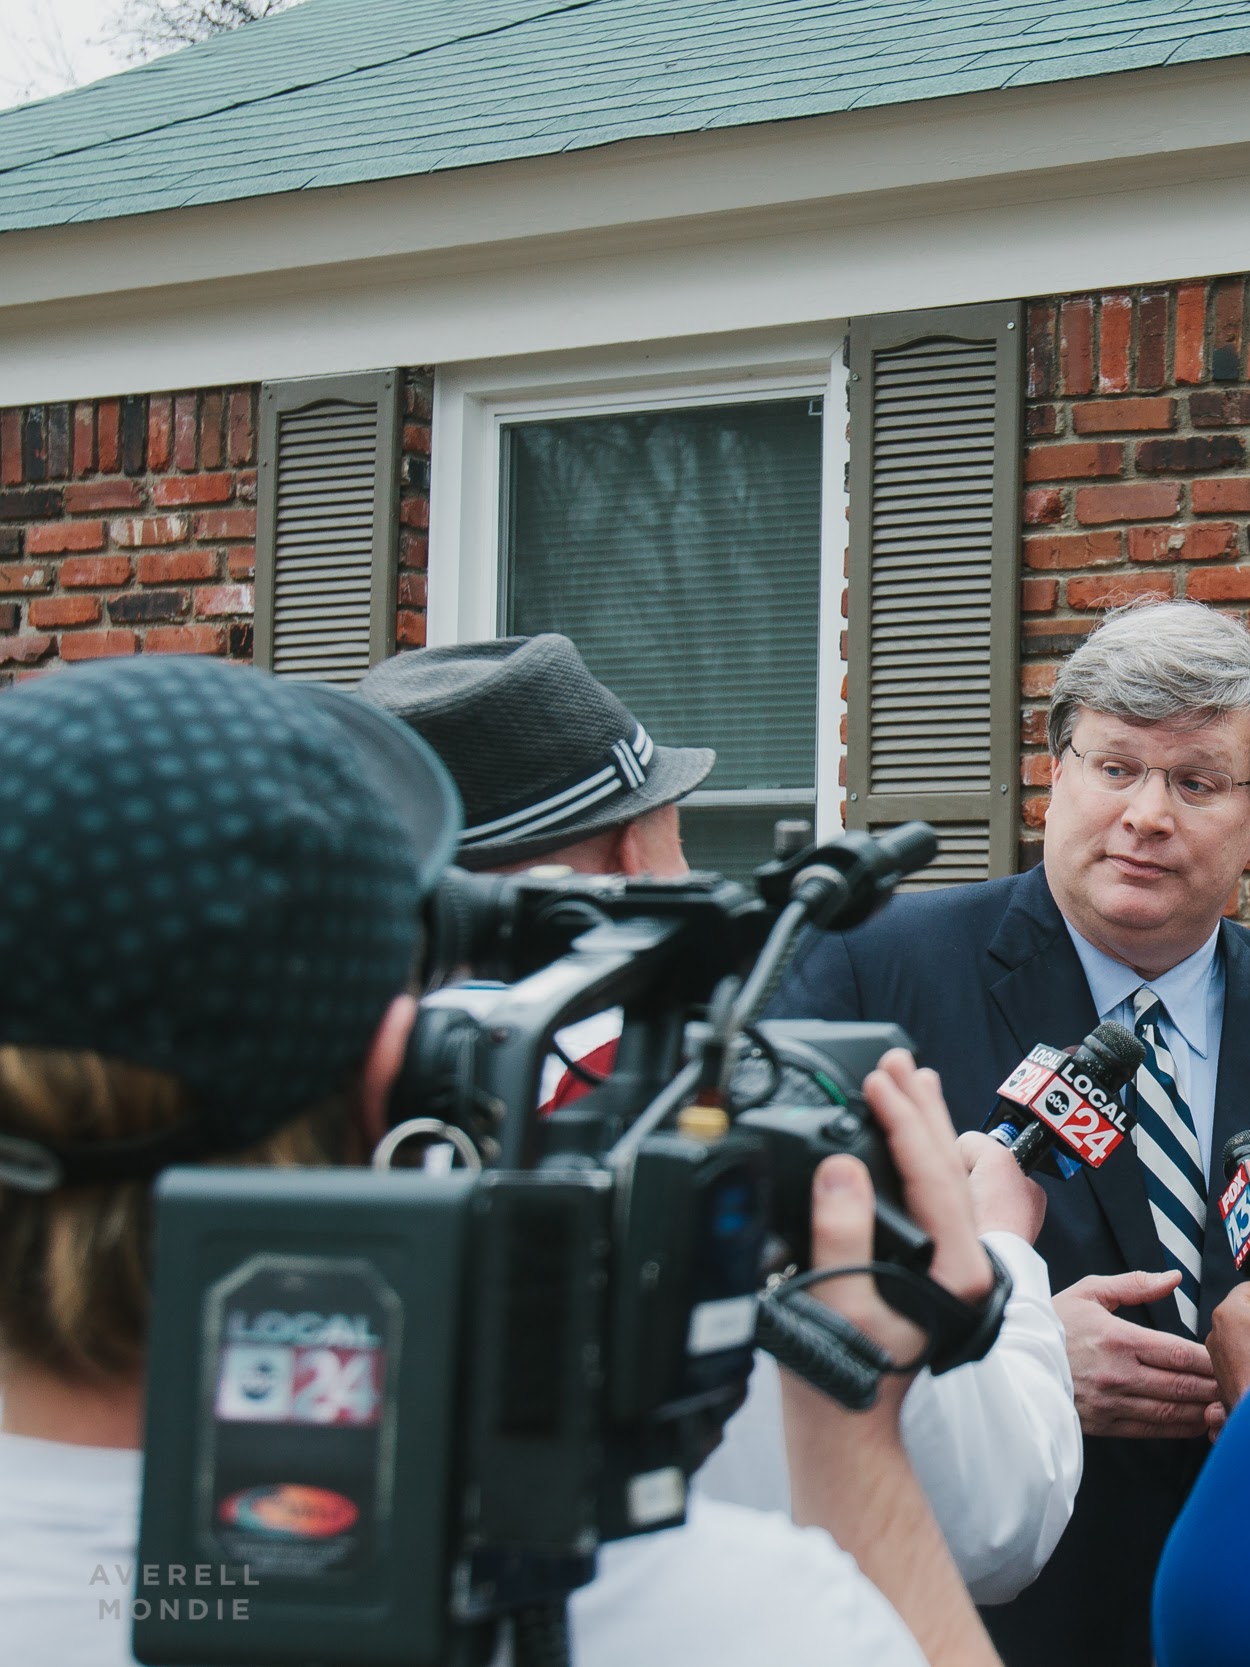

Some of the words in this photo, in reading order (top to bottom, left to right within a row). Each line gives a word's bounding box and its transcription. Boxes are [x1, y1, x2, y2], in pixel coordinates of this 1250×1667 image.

[1027, 1047, 1062, 1069] LOCAL
[1017, 1067, 1051, 1101] 24
[1061, 1062, 1127, 1132] LOCAL
[1046, 1092, 1068, 1114] abc
[1060, 1107, 1118, 1162] 24
[1221, 1169, 1246, 1215] FOX
[227, 1310, 382, 1347] LOCAL
[292, 1349, 375, 1424] 24
